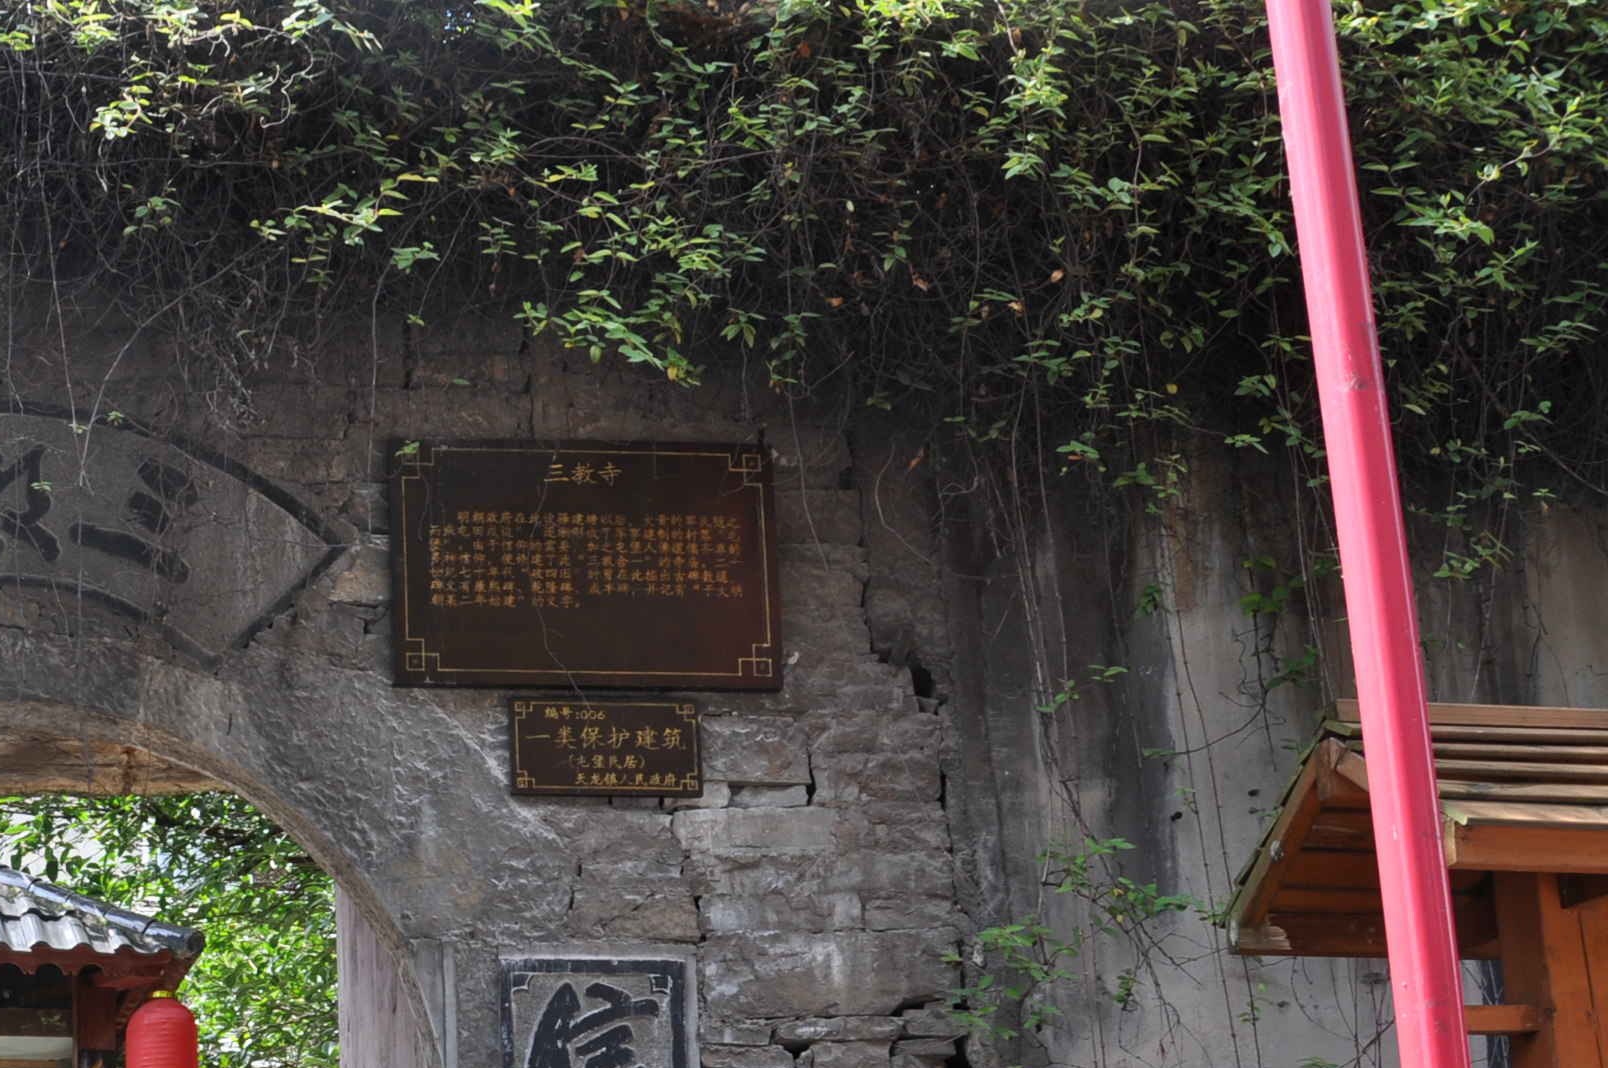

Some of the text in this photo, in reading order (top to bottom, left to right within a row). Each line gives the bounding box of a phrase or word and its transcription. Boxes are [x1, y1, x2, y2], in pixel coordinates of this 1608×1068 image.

[544, 462, 623, 487] 三教寺
[525, 725, 688, 750] 一类保护建筑
[574, 772, 677, 786] 天龙镇人民政府
